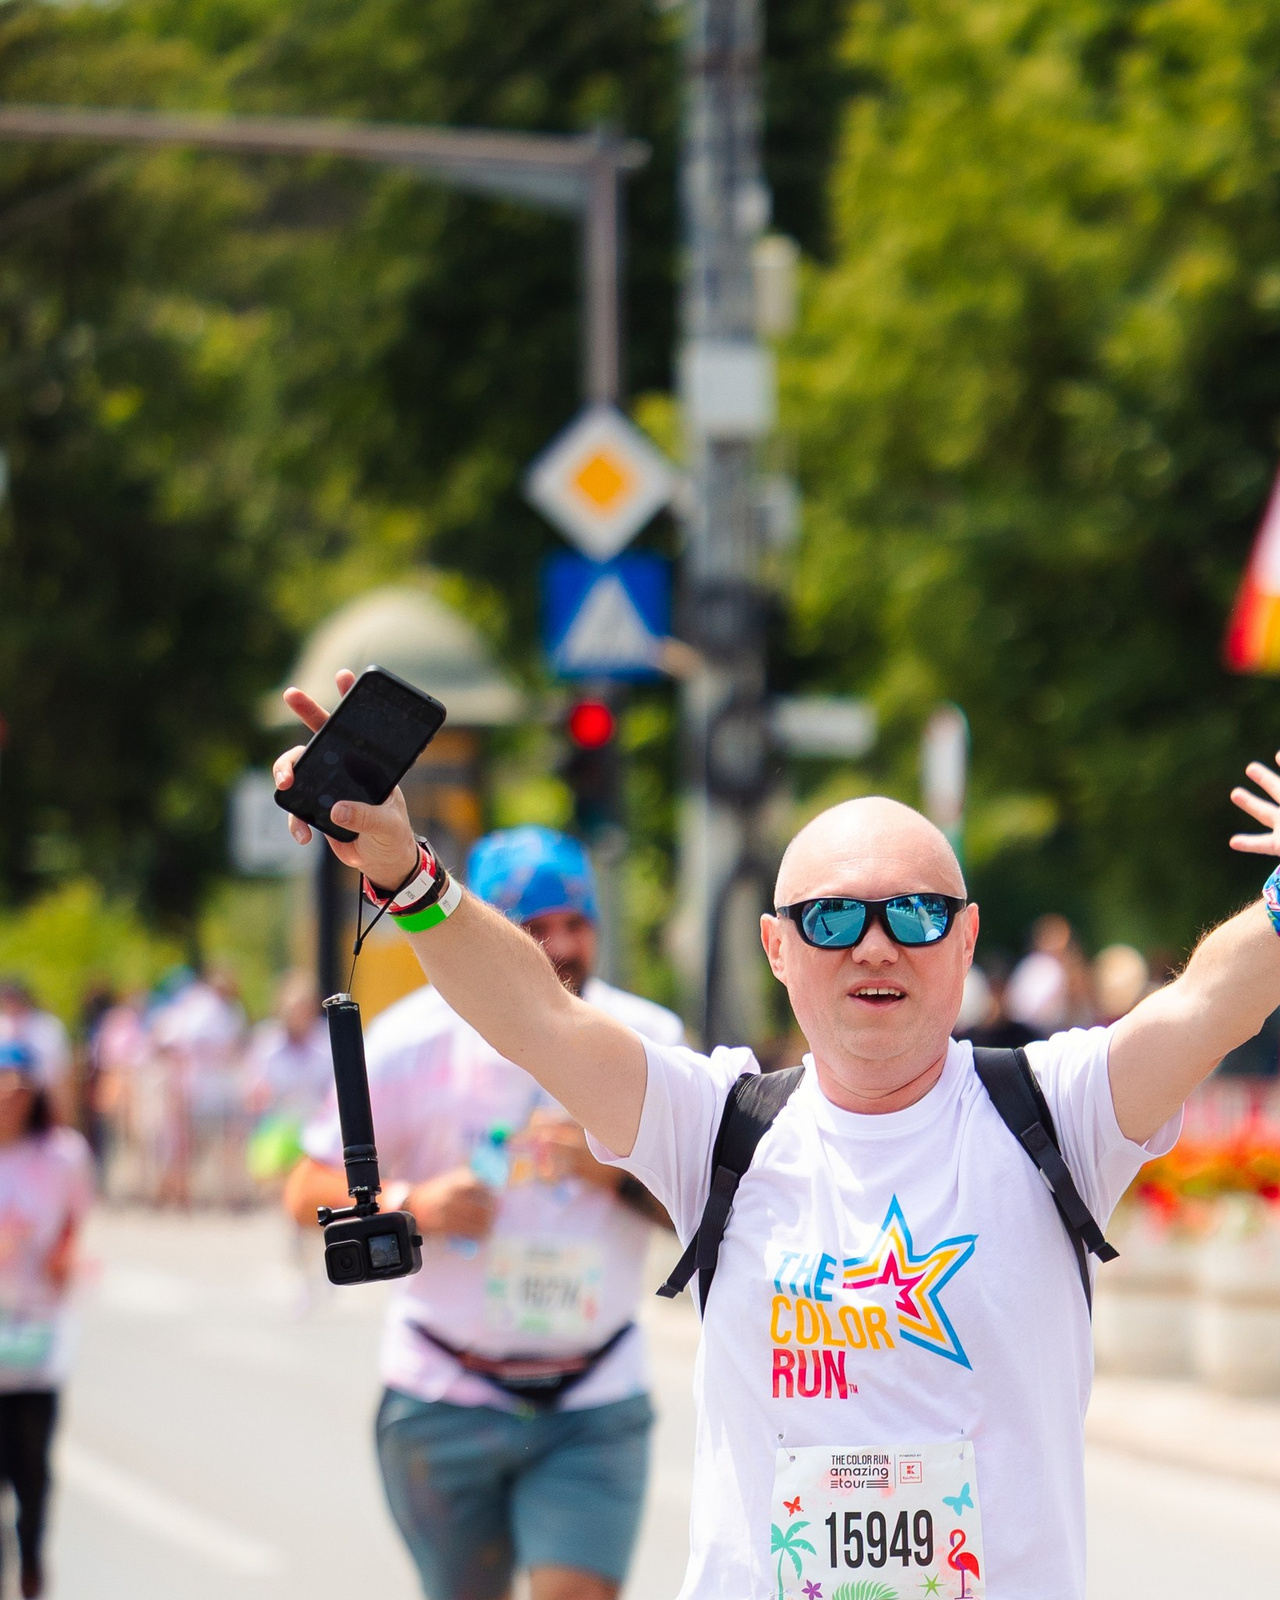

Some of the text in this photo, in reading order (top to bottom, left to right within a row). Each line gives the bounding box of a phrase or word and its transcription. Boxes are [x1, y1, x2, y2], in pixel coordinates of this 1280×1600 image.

[772, 1250, 838, 1302] THE
[770, 1294, 896, 1350] COLOR
[830, 1465, 889, 1479] amazing
[831, 1454, 845, 1465] THE
[846, 1454, 873, 1465] COLOR
[839, 1478, 866, 1489] tour
[825, 1509, 934, 1569] 15949
